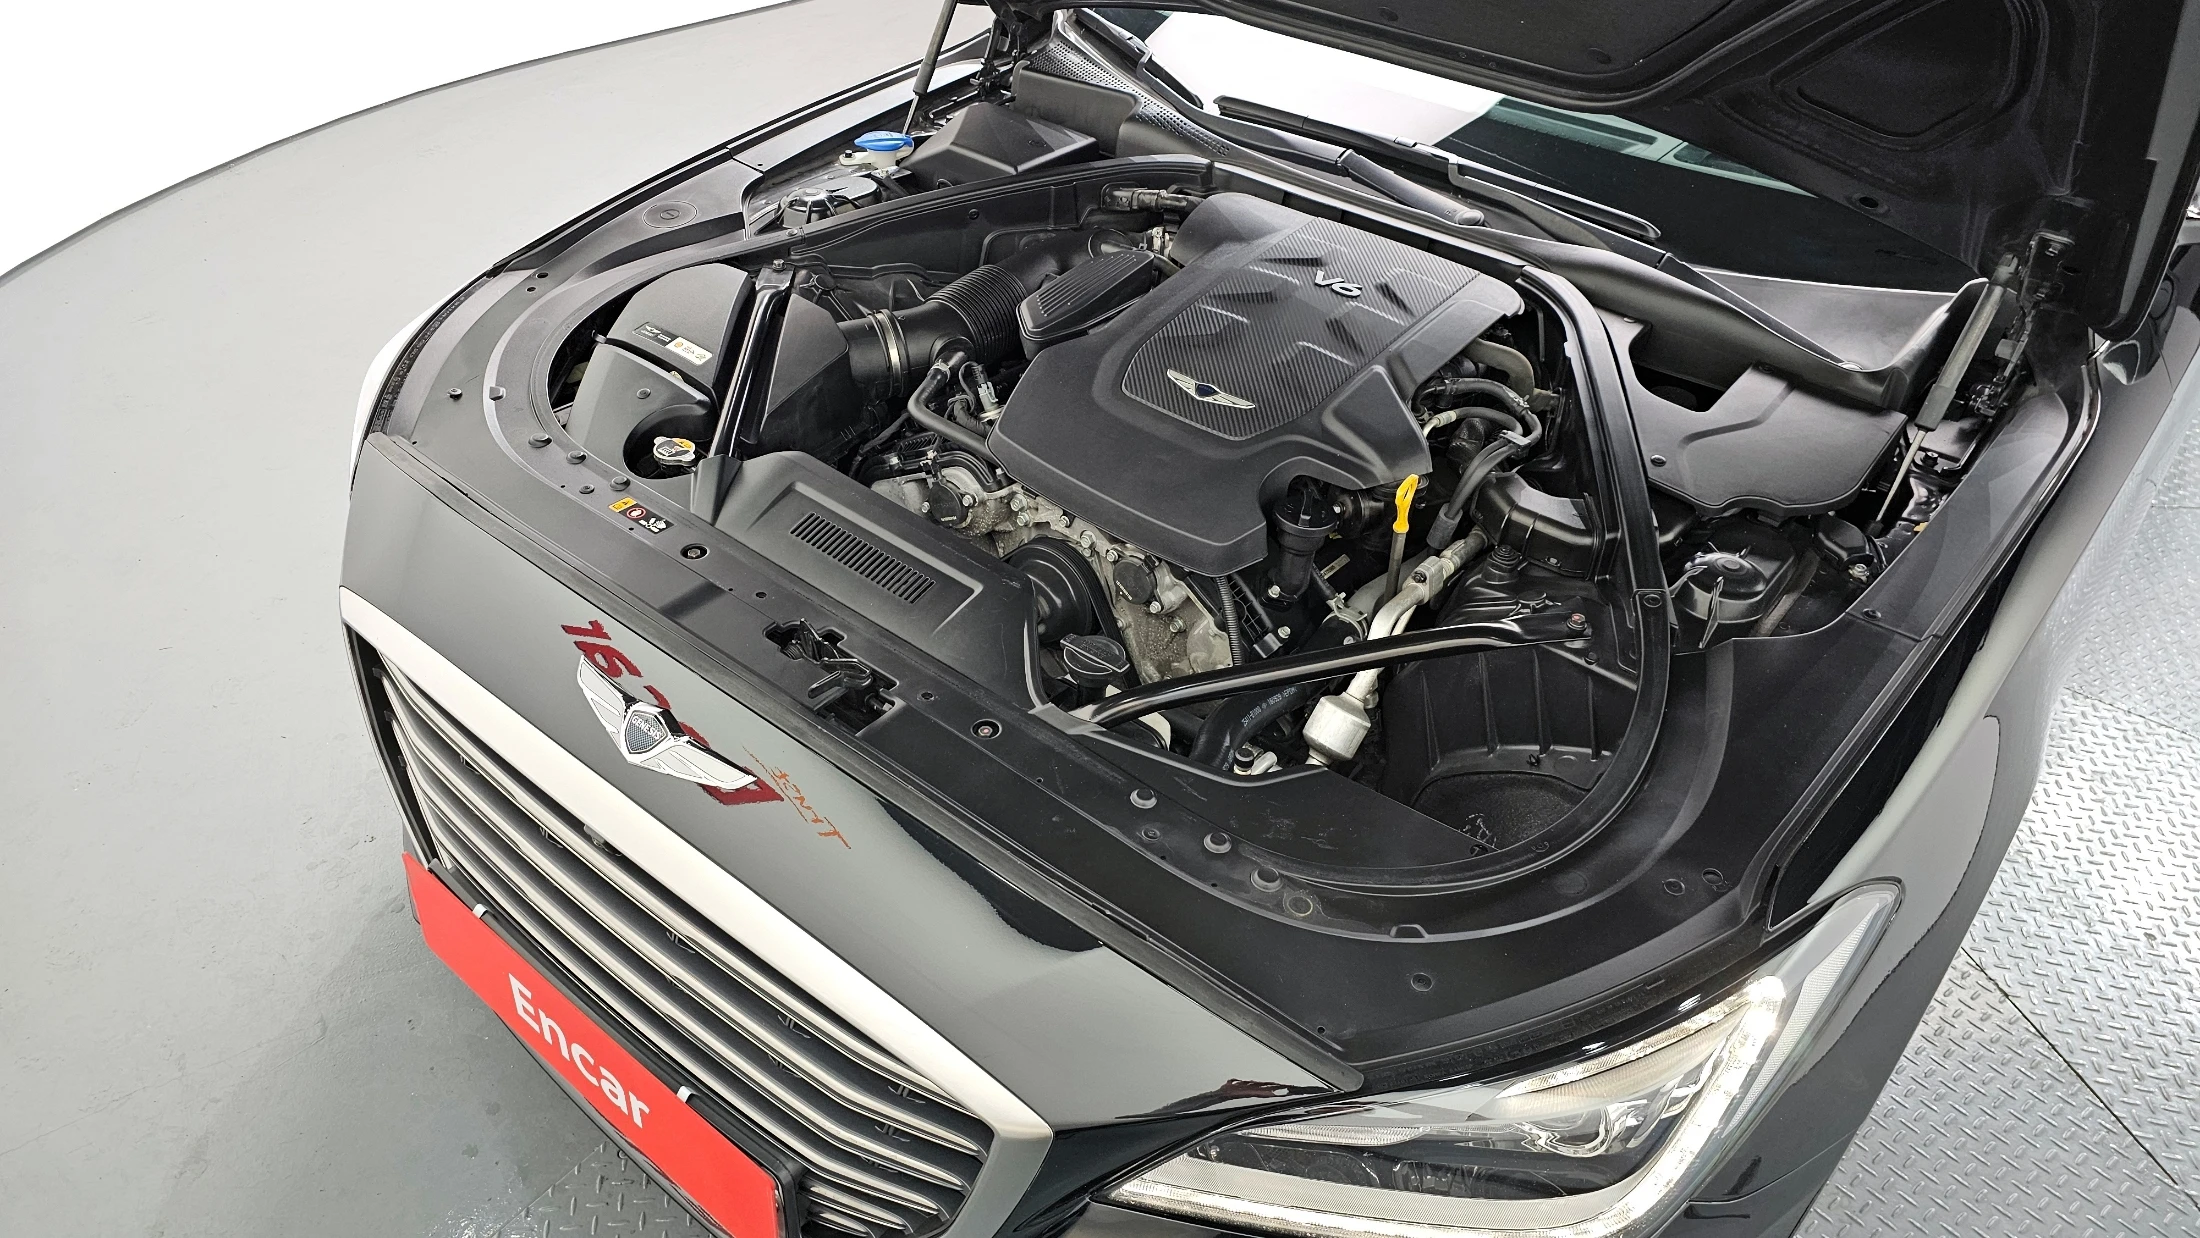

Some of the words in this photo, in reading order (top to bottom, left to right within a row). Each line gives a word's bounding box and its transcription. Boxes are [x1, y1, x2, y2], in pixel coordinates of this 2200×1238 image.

[1314, 269, 1363, 298] V6
[631, 715, 663, 742] GENESIS
[508, 972, 650, 1128] Encar
